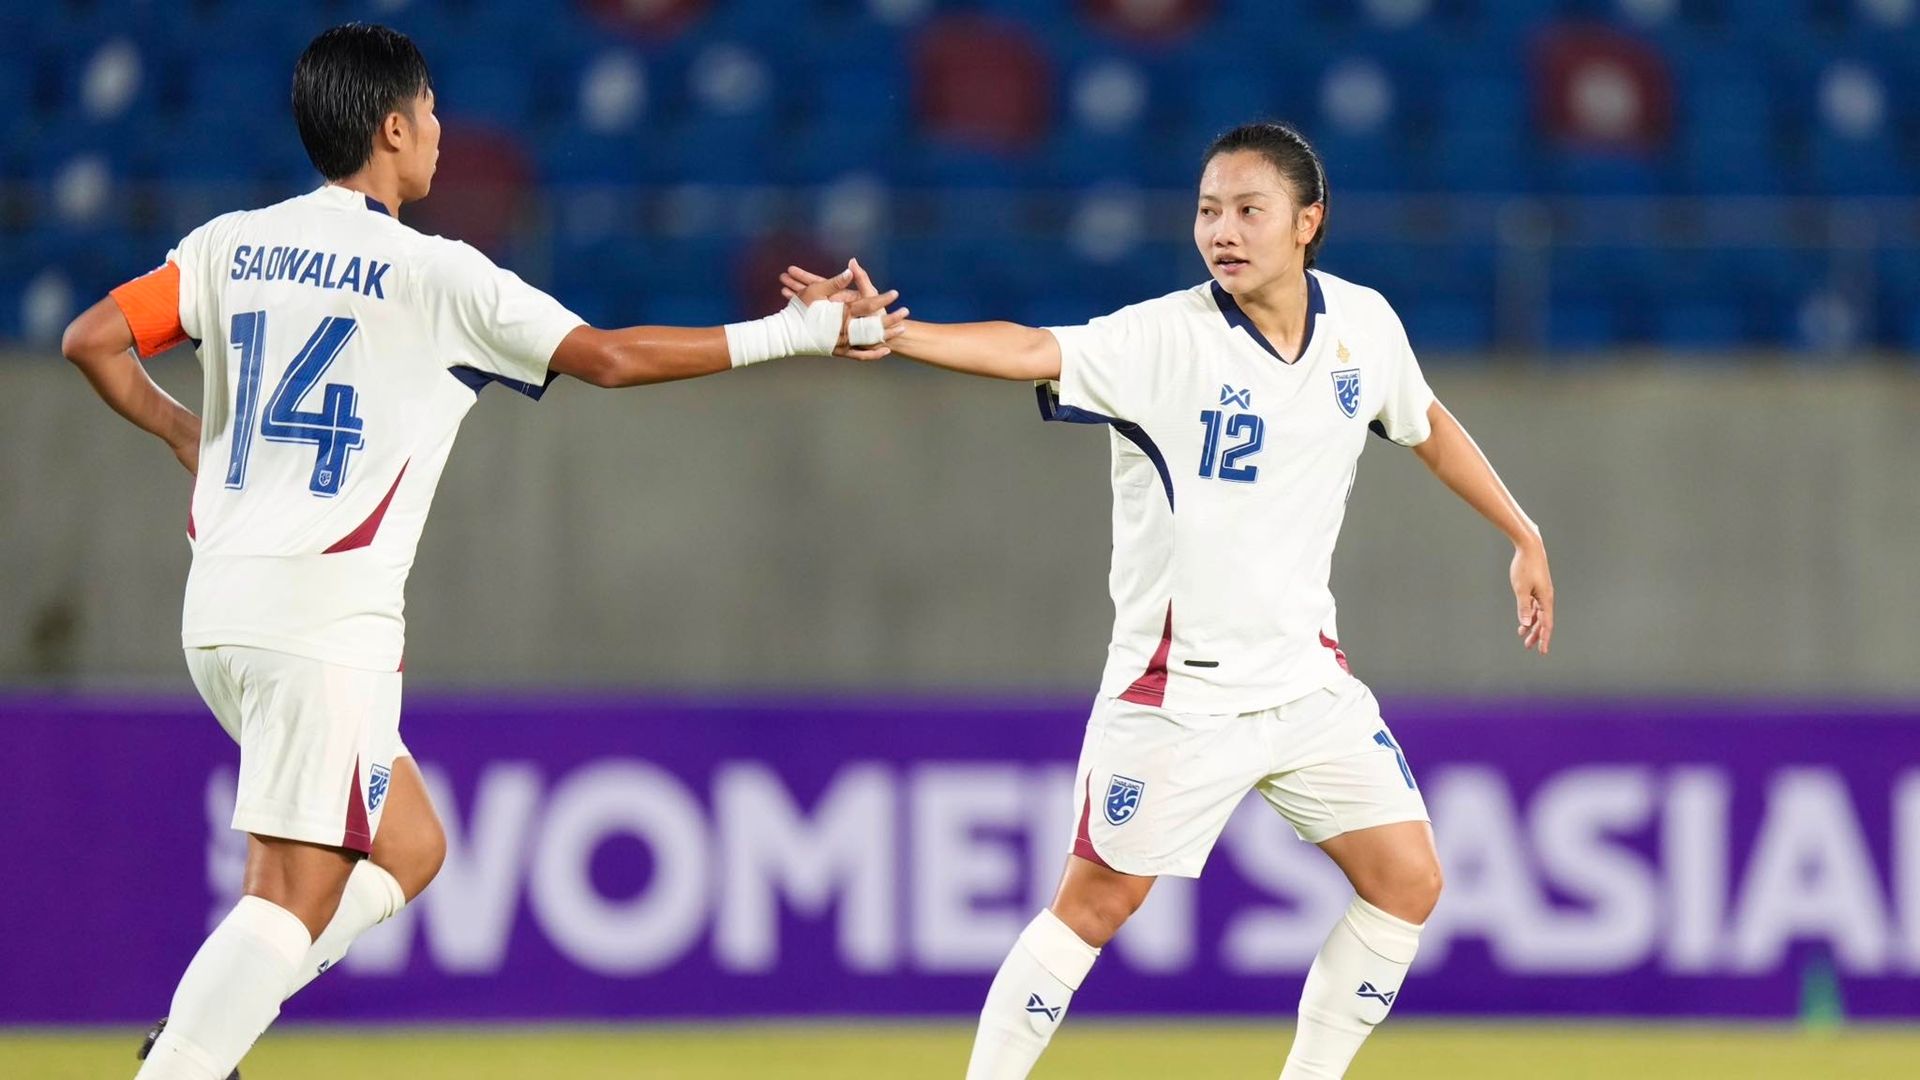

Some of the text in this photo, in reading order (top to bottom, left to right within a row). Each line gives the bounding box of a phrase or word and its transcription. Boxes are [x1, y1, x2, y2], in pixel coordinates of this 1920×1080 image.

[231, 244, 391, 300] SAOWALAK
[225, 310, 365, 497] 14
[1199, 410, 1266, 483] 12
[1408, 763, 1920, 976] ASIA
